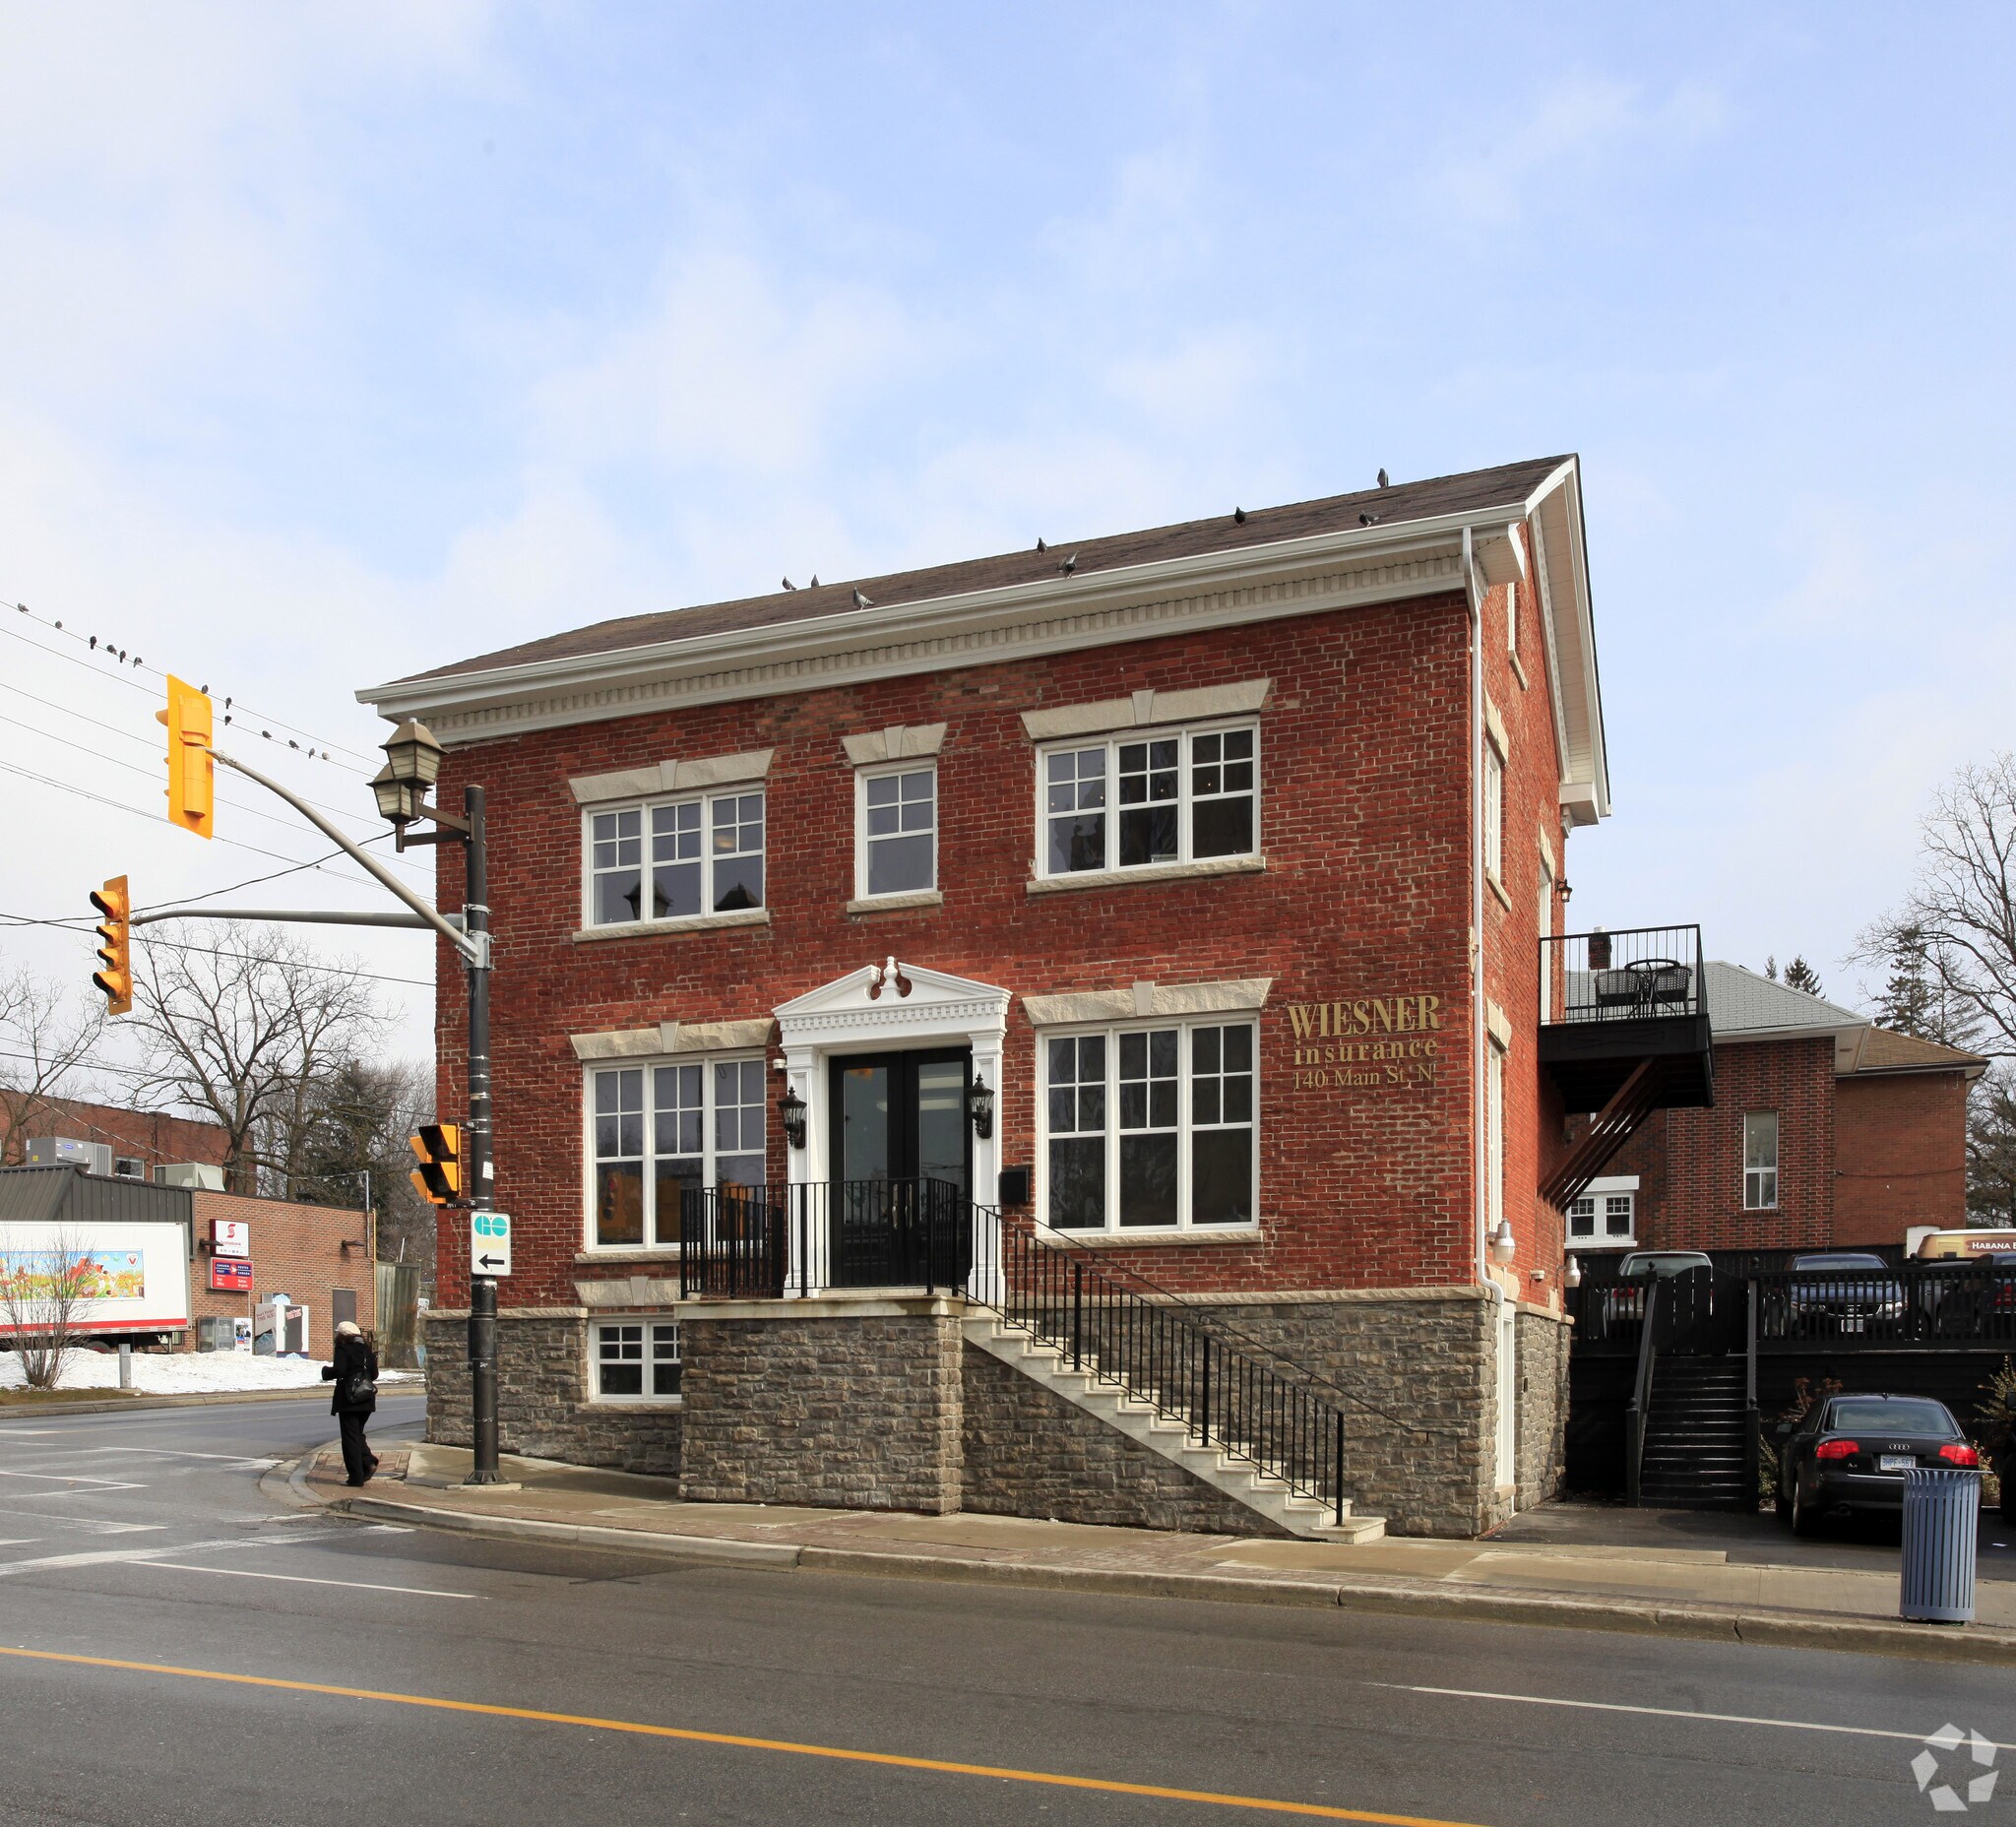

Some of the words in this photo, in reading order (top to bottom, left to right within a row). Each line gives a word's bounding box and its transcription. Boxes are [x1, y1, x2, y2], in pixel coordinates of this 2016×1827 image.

[1287, 995, 1440, 1040] WIESNER
[1293, 1040, 1437, 1065] insurance
[1294, 1069, 1326, 1090] 140
[1335, 1069, 1380, 1086] Main
[1418, 1063, 1434, 1082] N
